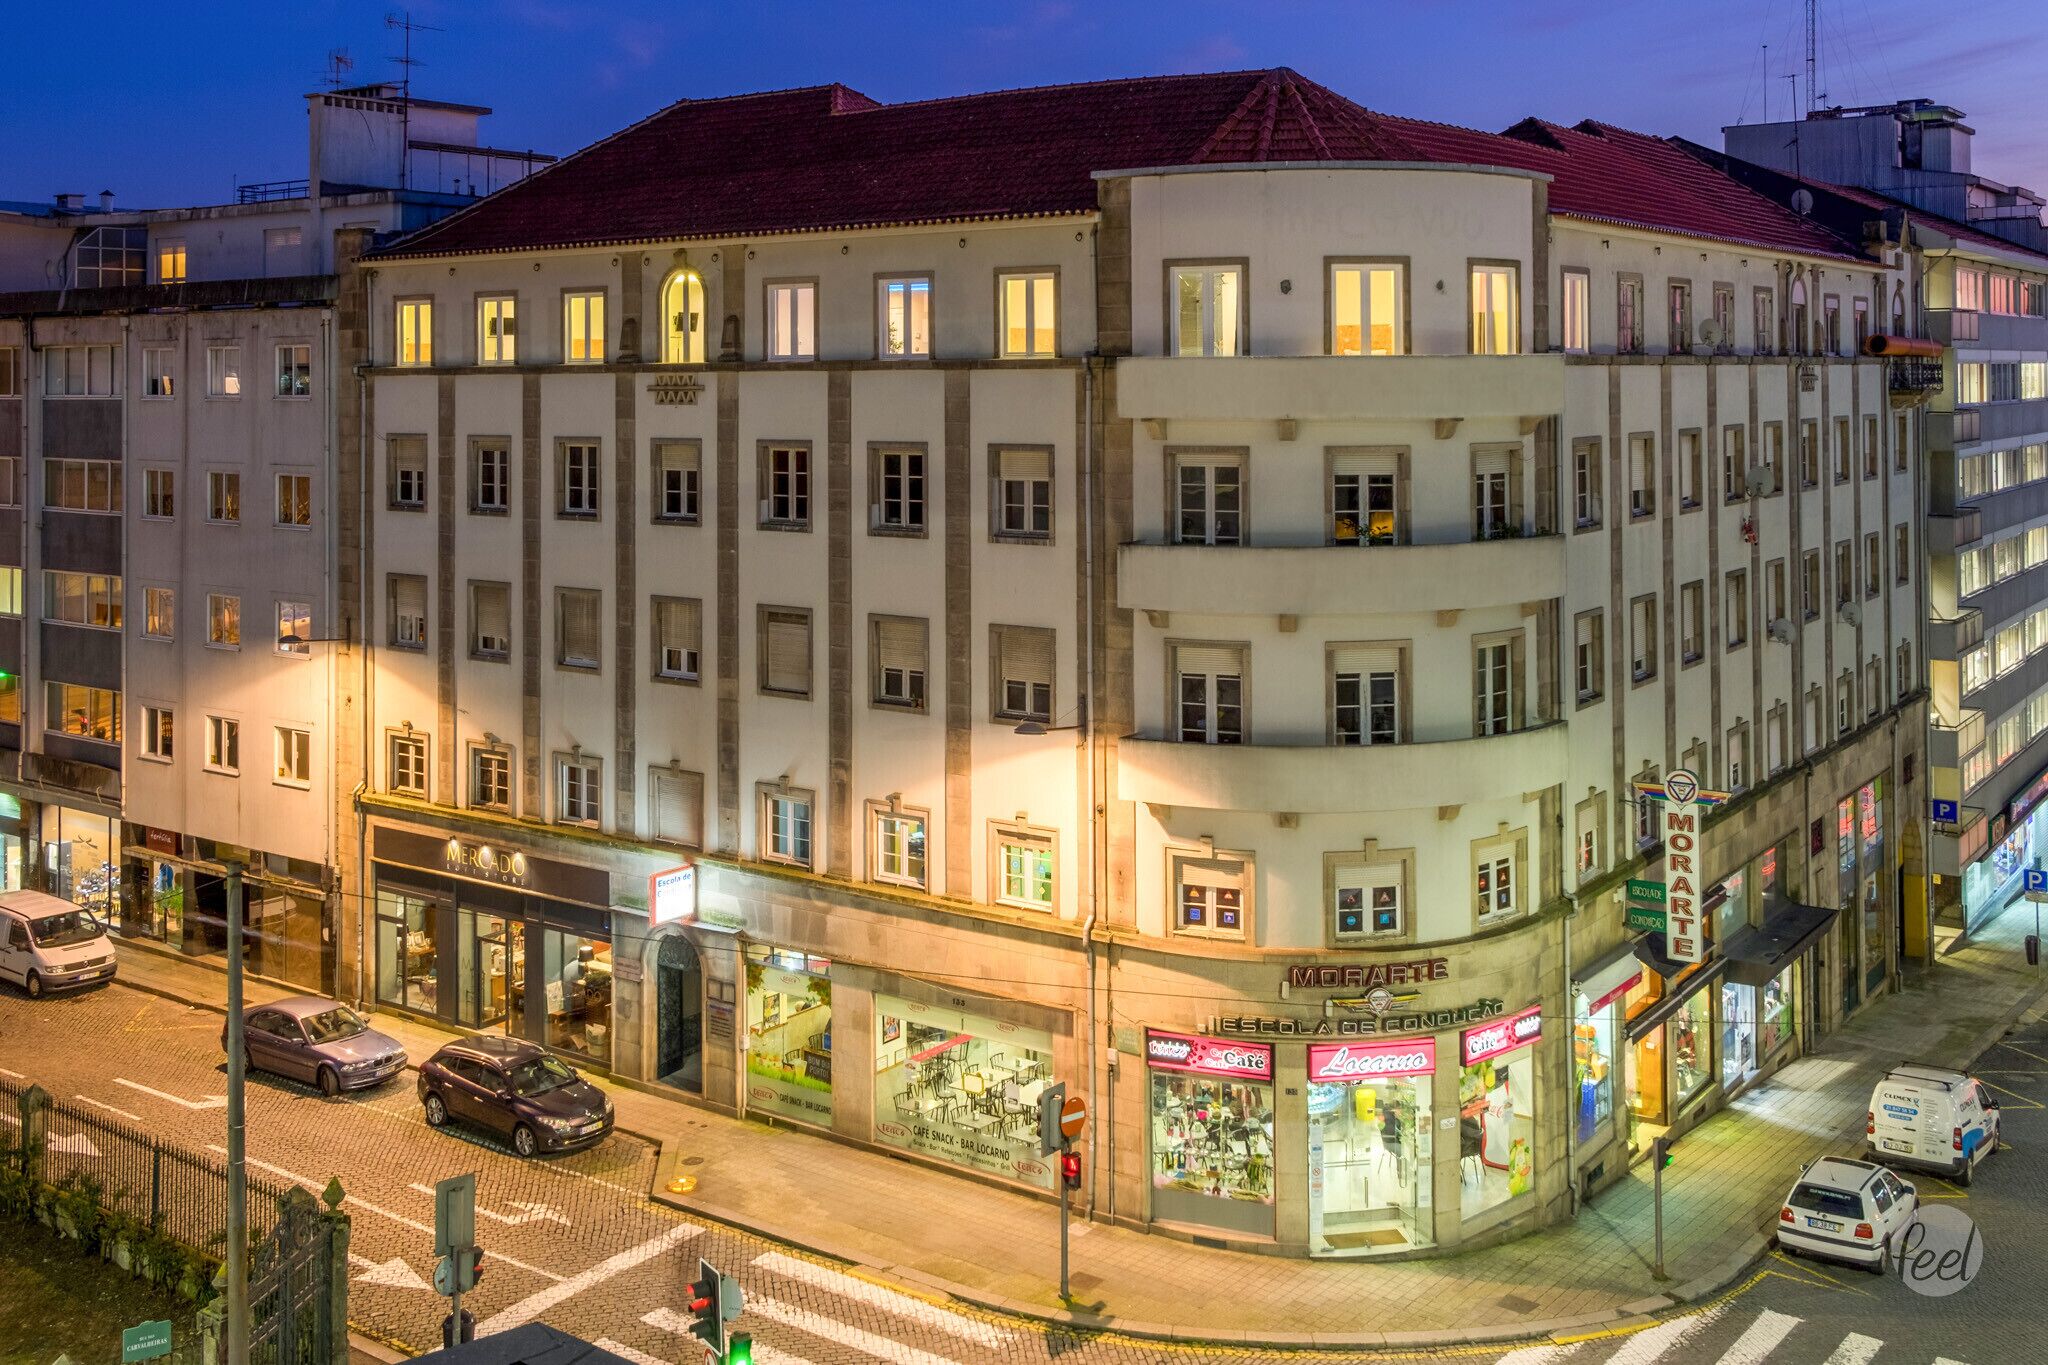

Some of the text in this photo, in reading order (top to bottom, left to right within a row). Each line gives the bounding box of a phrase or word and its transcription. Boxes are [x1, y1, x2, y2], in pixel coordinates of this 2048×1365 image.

[447, 842, 525, 876] MERCADO
[657, 872, 692, 888] Escola de
[1667, 812, 1695, 958] MORARTE
[1289, 957, 1449, 988] MORARTE
[1222, 1017, 1333, 1035] ESCOLA
[1340, 1021, 1376, 1035] DE
[1385, 999, 1505, 1032] CONDUÇÃO
[1222, 1050, 1265, 1070] Café
[1320, 1047, 1428, 1076] Locarno
[913, 1125, 929, 1139] CAFÉ
[931, 1130, 954, 1146] SNACK
[960, 1138, 975, 1152] BAR
[976, 1143, 1010, 1161] LOCARNO
